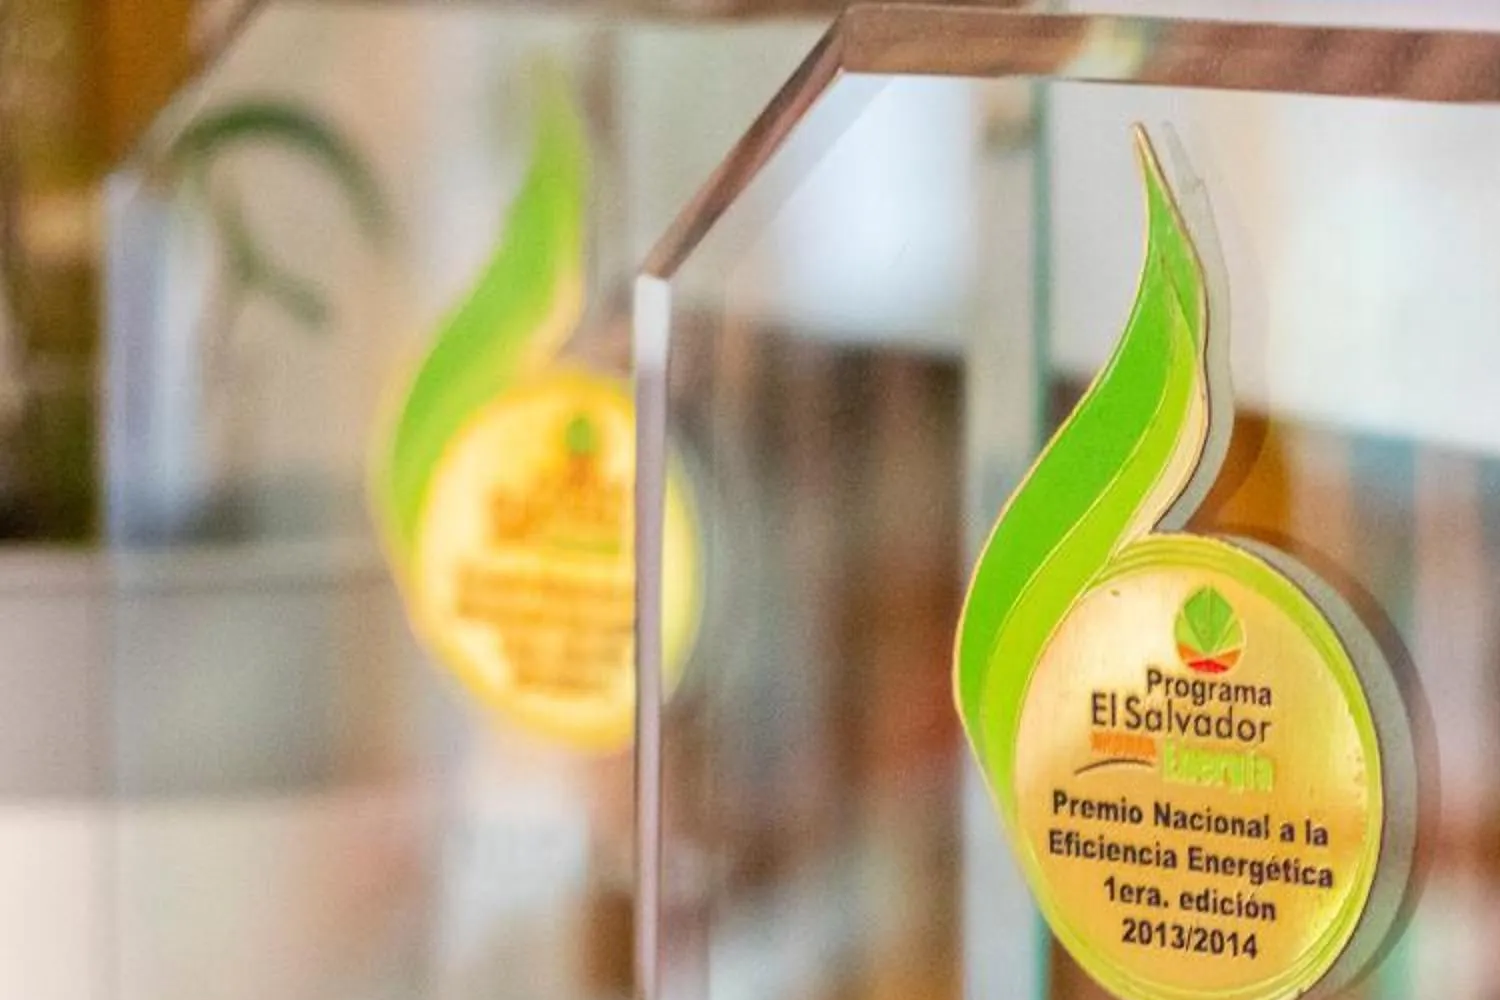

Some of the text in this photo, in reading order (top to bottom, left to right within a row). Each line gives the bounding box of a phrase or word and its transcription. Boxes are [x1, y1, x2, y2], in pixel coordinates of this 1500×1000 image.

[1146, 668, 1273, 707] Programa
[1091, 691, 1272, 743] El Salvador
[1052, 790, 1329, 846] Premio Nacional a la
[1048, 829, 1334, 888] Eficiencia Energética
[1103, 876, 1277, 921] 1era. edición
[1121, 918, 1259, 959] 2013/2014
